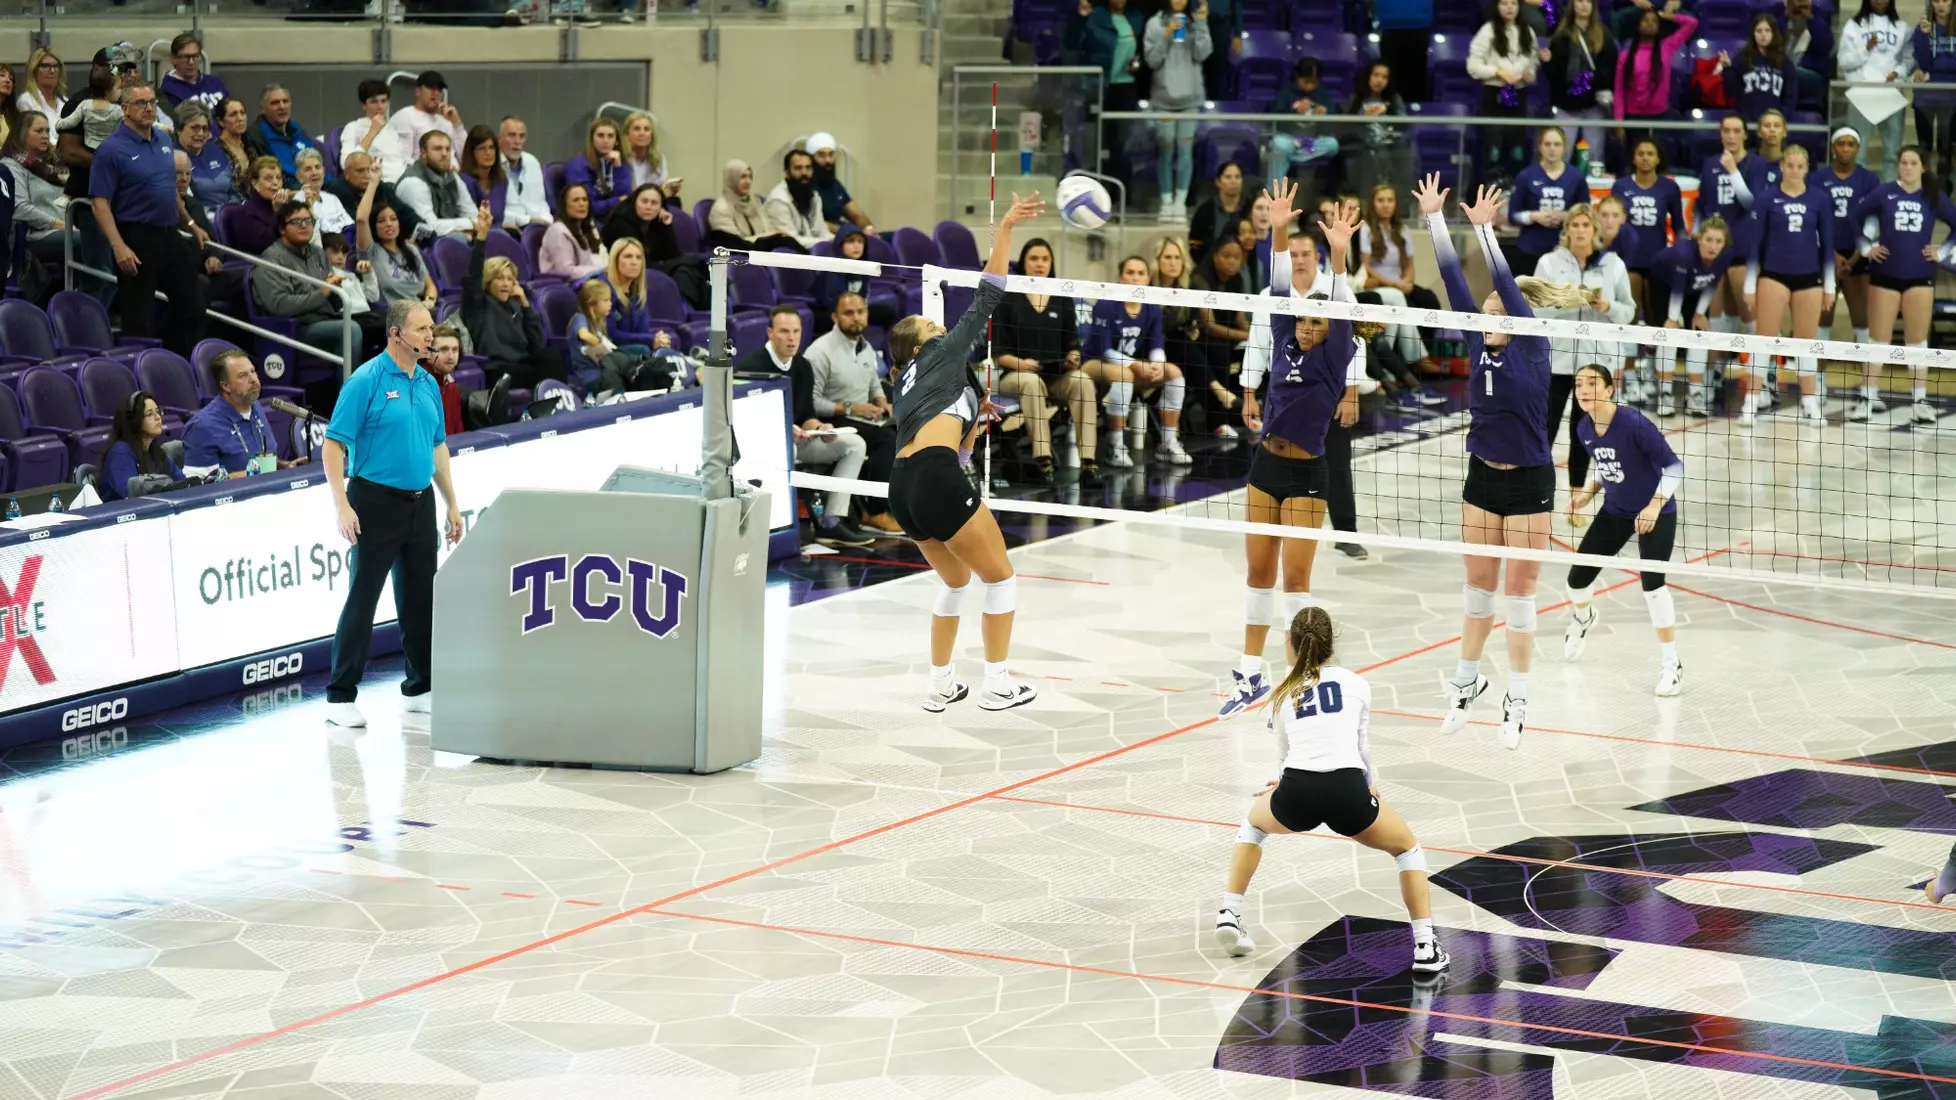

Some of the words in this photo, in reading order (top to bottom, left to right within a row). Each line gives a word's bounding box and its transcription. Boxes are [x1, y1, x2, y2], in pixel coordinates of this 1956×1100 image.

[1743, 71, 1784, 97] TCU
[1716, 187, 1735, 204] 12
[1831, 186, 1854, 198] TCU
[1631, 195, 1656, 207] TCU
[1783, 203, 1807, 214] TCU
[1834, 200, 1848, 217] 3
[1897, 200, 1921, 212] TCU
[1630, 207, 1657, 226] 35
[1788, 215, 1803, 232] 2
[1894, 211, 1924, 232] 23
[266, 361, 283, 372] TCU
[1484, 370, 1493, 396] 1
[1594, 447, 1616, 459] TCU
[1596, 460, 1626, 484] 25
[117, 513, 137, 523] GEICO
[29, 530, 50, 540] GEICO
[200, 546, 301, 604] Official
[509, 553, 689, 640] TCU
[242, 652, 303, 685] GEICO
[1290, 681, 1344, 720] 20
[62, 698, 128, 732] GEICO
